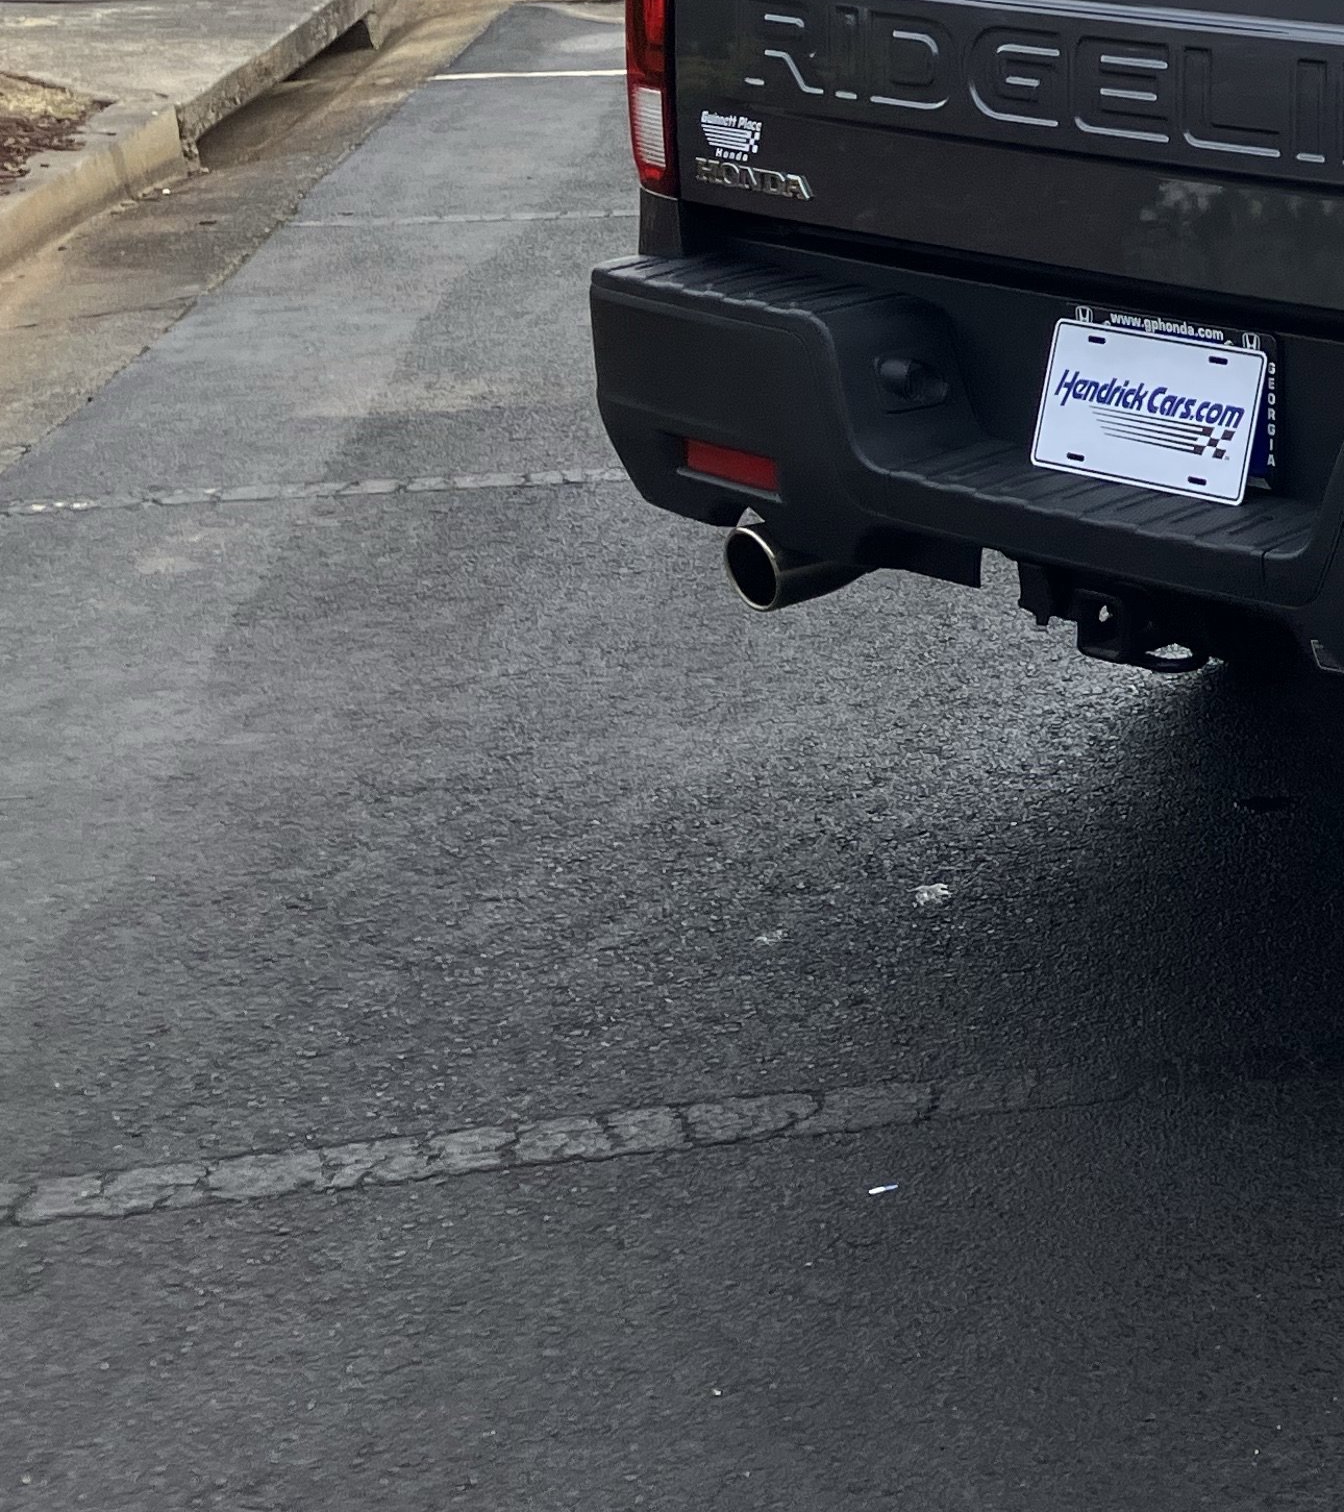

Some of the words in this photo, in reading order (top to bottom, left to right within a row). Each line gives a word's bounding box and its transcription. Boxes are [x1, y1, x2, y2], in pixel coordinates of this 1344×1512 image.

[738, 117, 762, 131] Place
[716, 148, 748, 161] Honda
[695, 157, 813, 200] HONDA
[1110, 313, 1223, 340] www.gphonda.com
[1267, 362, 1276, 467] GEORGIA
